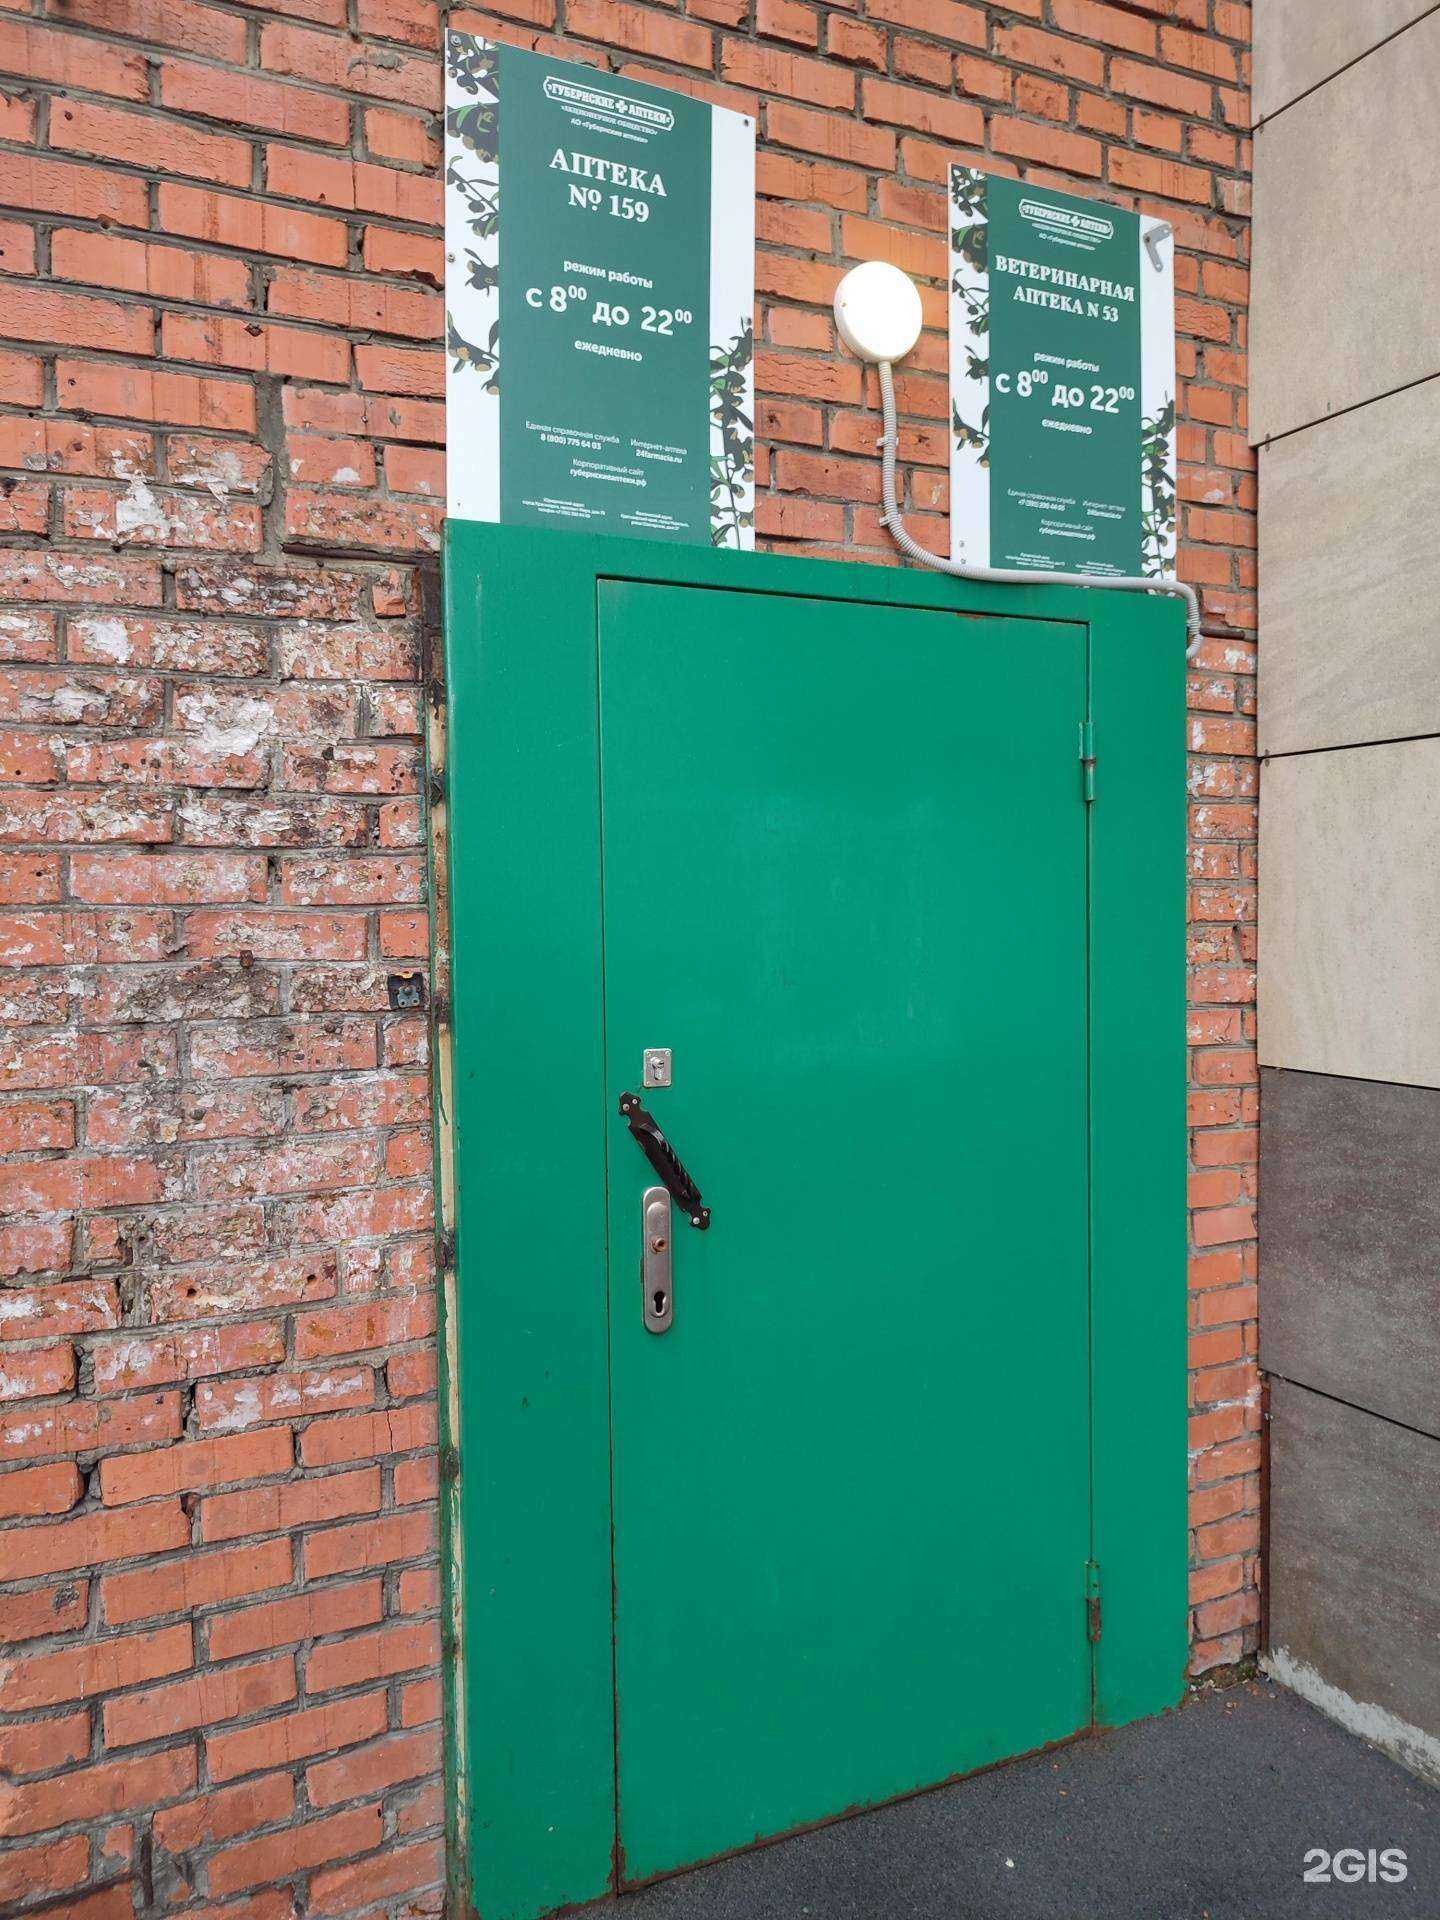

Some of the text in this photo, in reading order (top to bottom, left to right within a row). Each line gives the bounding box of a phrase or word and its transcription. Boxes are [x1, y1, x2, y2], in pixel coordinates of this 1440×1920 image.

[549, 148, 667, 197] АПТЕКА
[568, 184, 650, 223] № 159
[563, 260, 653, 289] режим работы
[995, 254, 1135, 302] ВЕТЕРИНАРНАЯ
[1013, 285, 1119, 322] АПТЕКА N 53
[574, 340, 643, 362] ежедневно
[1065, 359, 1099, 373] работы
[1041, 418, 1093, 435] ежедневно
